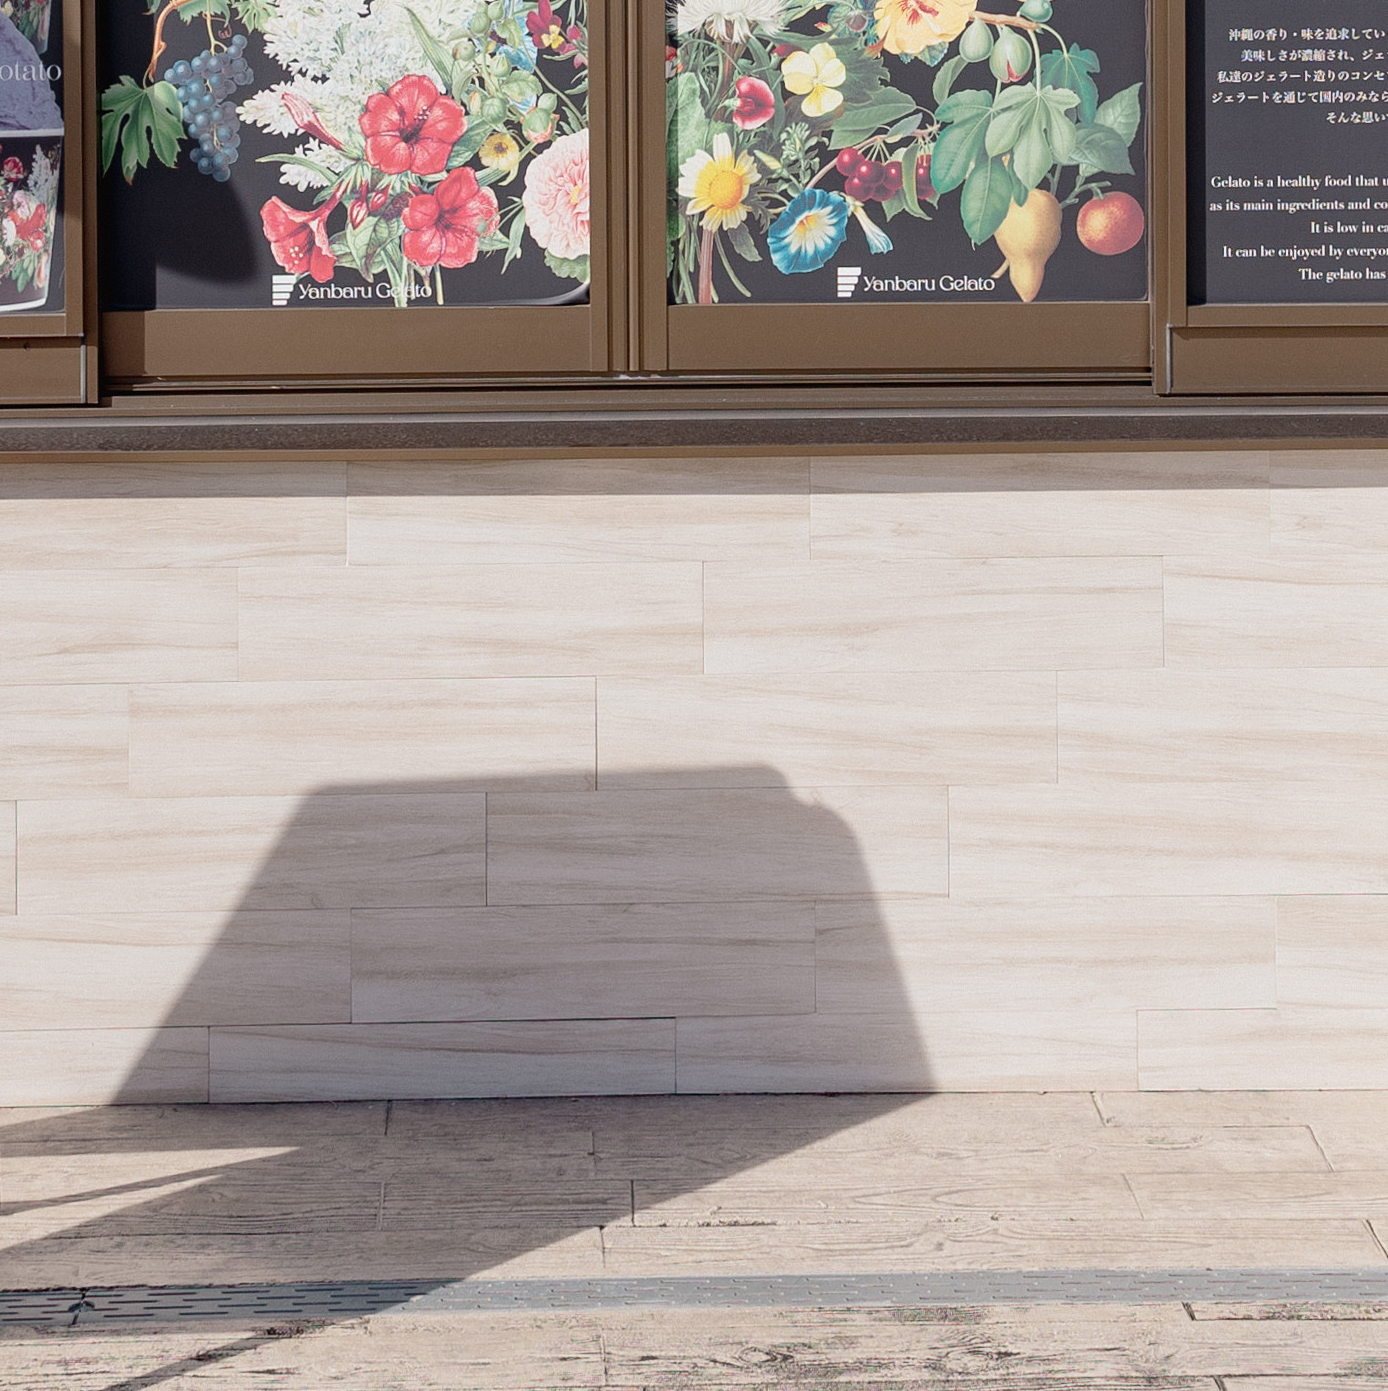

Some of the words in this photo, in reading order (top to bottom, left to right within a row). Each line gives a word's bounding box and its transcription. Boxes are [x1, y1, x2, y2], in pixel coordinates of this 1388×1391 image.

[1211, 176, 1251, 188] Gelato
[1254, 176, 1263, 187] is
[1266, 178, 1273, 187] a
[1277, 175, 1321, 190] healthy
[1324, 175, 1352, 187] food
[1355, 175, 1380, 187] that
[1209, 202, 1222, 211] as
[1225, 199, 1240, 211] its
[1243, 199, 1273, 211] main
[1277, 198, 1344, 214] ingredients
[1347, 198, 1370, 210] and
[1311, 222, 1320, 234] It
[1323, 222, 1334, 234] is
[1337, 222, 1359, 233] low
[1362, 222, 1374, 233] in
[1223, 246, 1232, 257] It
[1235, 248, 1257, 257] can
[1260, 245, 1275, 257] be
[1278, 245, 1326, 260] enjoyed
[1329, 244, 1344, 259] by
[863, 275, 936, 292] Yanbaru
[939, 274, 996, 292] Gelato
[1298, 268, 1323, 280] The
[1326, 268, 1362, 284] gelato
[1365, 267, 1386, 279] has
[298, 283, 373, 300] Yanbaru
